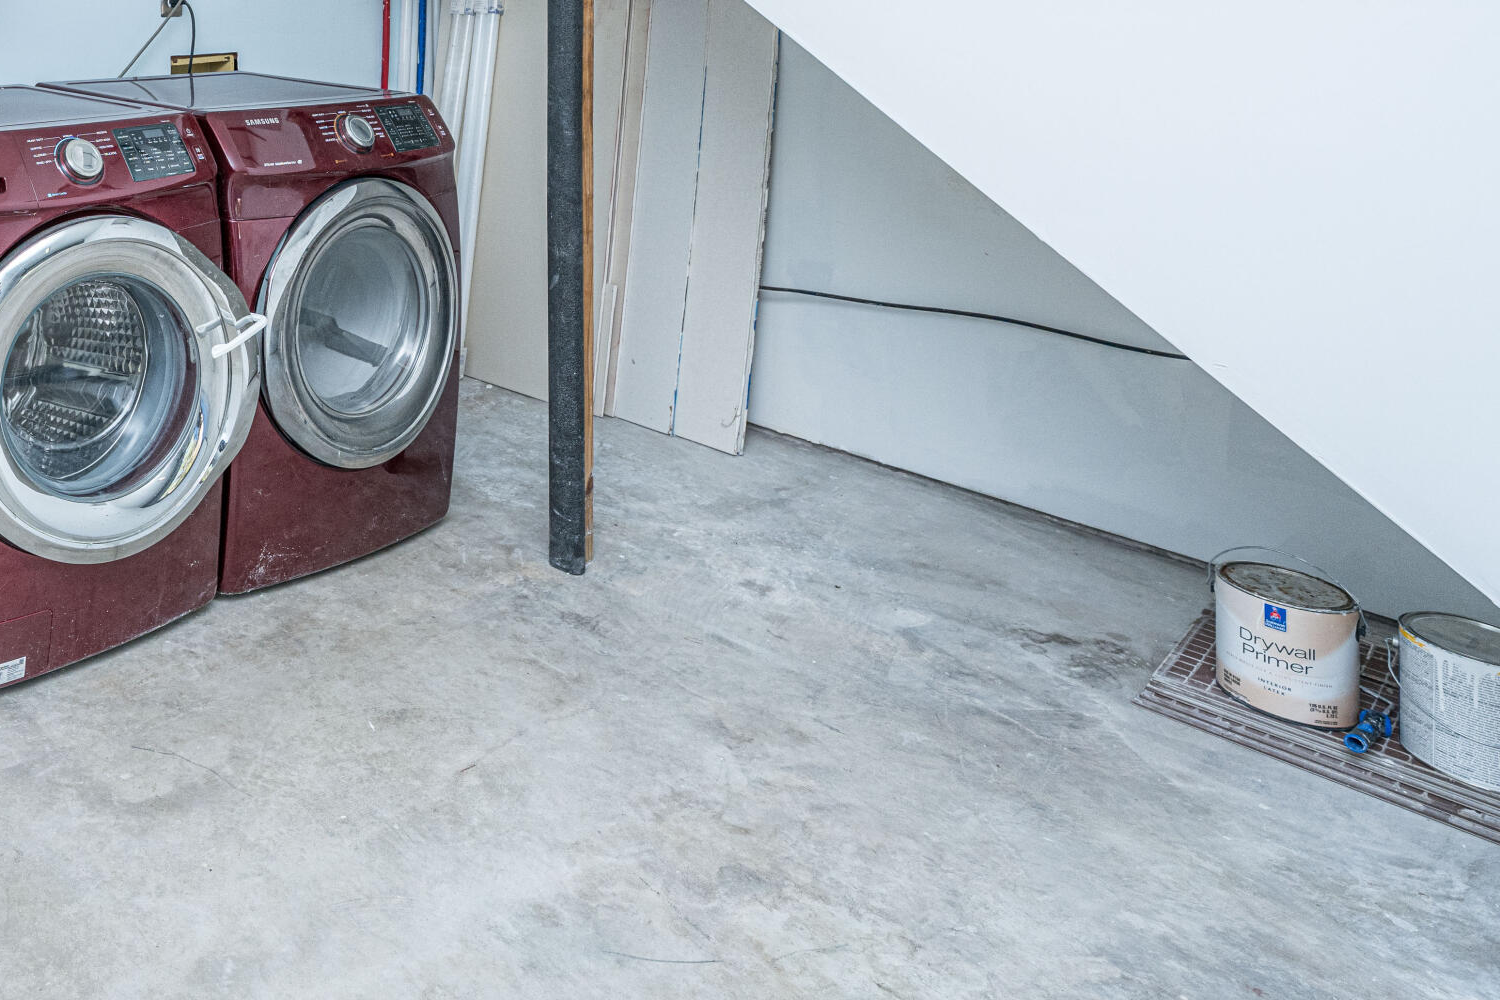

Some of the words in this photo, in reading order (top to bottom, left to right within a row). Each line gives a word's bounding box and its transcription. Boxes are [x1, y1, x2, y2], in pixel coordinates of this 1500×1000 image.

[245, 117, 279, 126] SAMSUNG
[1239, 626, 1316, 661] Drywall
[1242, 642, 1313, 675] Primer
[1257, 676, 1292, 692] INTERIOR
